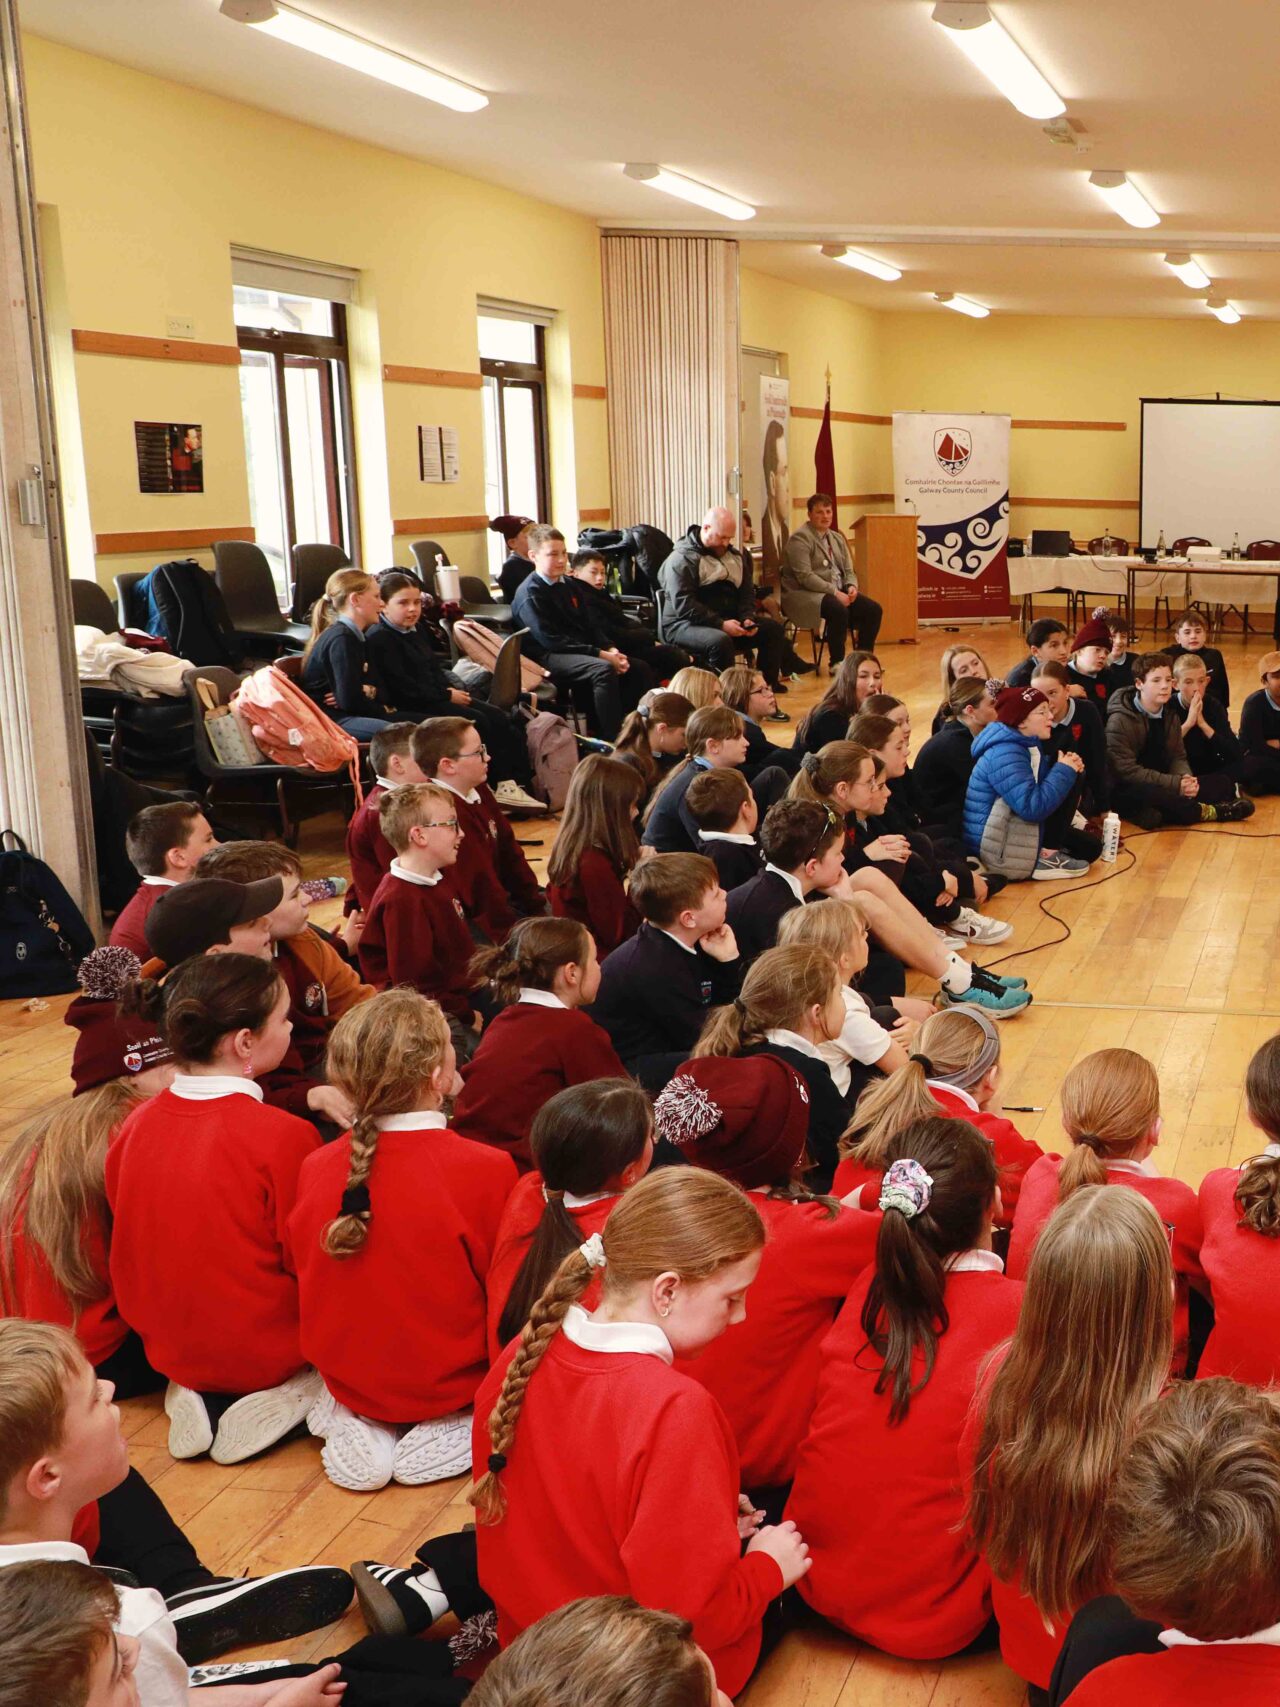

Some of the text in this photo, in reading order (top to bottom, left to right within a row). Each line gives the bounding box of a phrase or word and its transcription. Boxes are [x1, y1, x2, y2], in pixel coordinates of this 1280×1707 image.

[905, 478, 937, 486] Comhairle
[938, 478, 963, 486] Chontae
[1110, 827, 1118, 856] WATER
